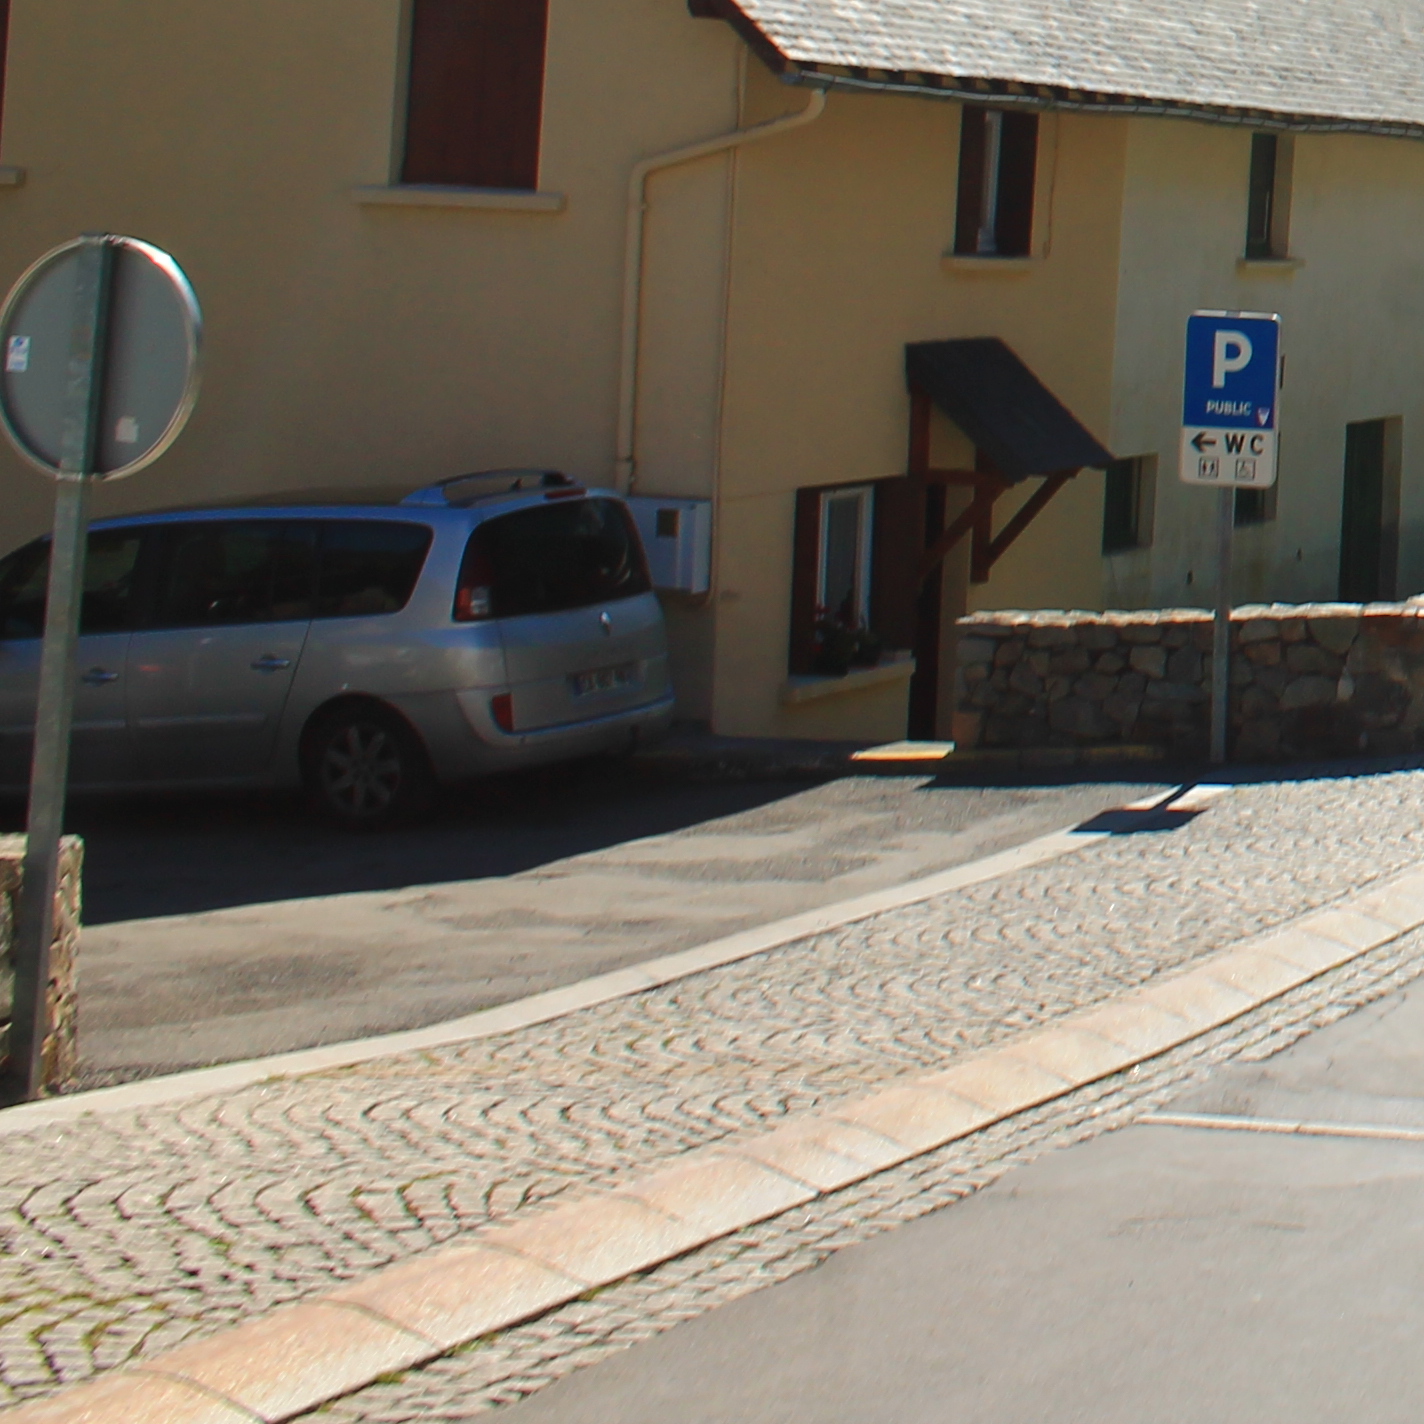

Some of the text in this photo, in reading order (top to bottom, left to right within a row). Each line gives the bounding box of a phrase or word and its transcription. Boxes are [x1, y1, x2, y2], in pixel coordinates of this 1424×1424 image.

[1212, 329, 1253, 389] P
[1206, 399, 1252, 417] PUBLIC
[1225, 433, 1264, 455] WC
